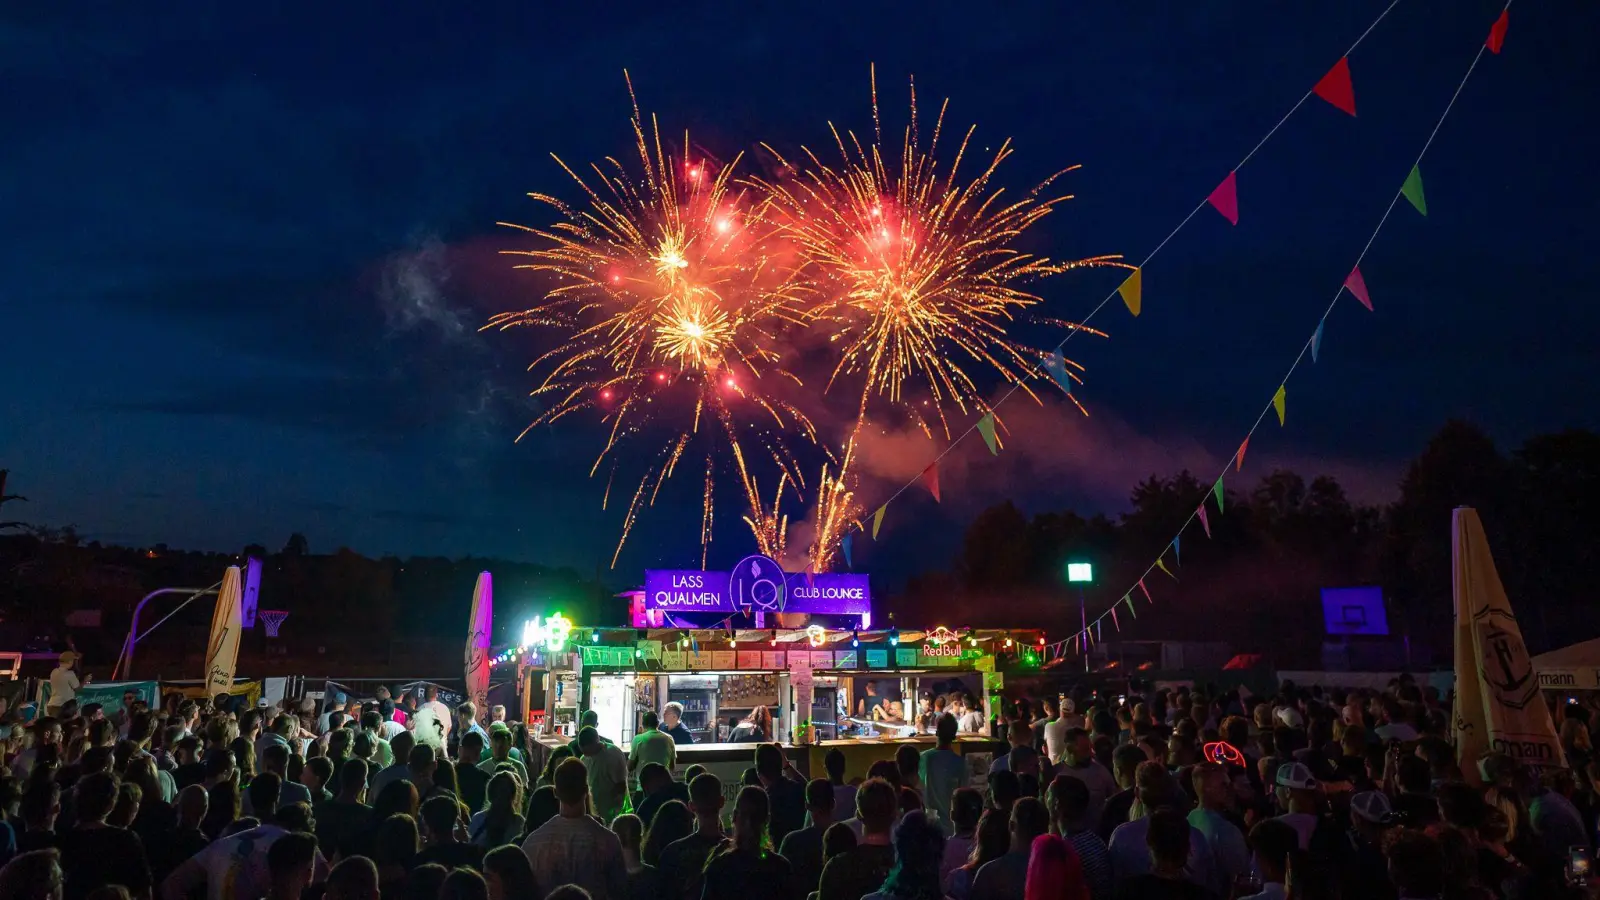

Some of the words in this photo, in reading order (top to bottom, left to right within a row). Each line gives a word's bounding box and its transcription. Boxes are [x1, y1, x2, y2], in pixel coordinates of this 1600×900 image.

[673, 575, 703, 588] LASS
[655, 591, 720, 606] QUALMEN
[793, 587, 819, 598] CLUB
[822, 588, 863, 599] LOUNGE
[923, 644, 942, 656] Red
[943, 644, 962, 656] Bull
